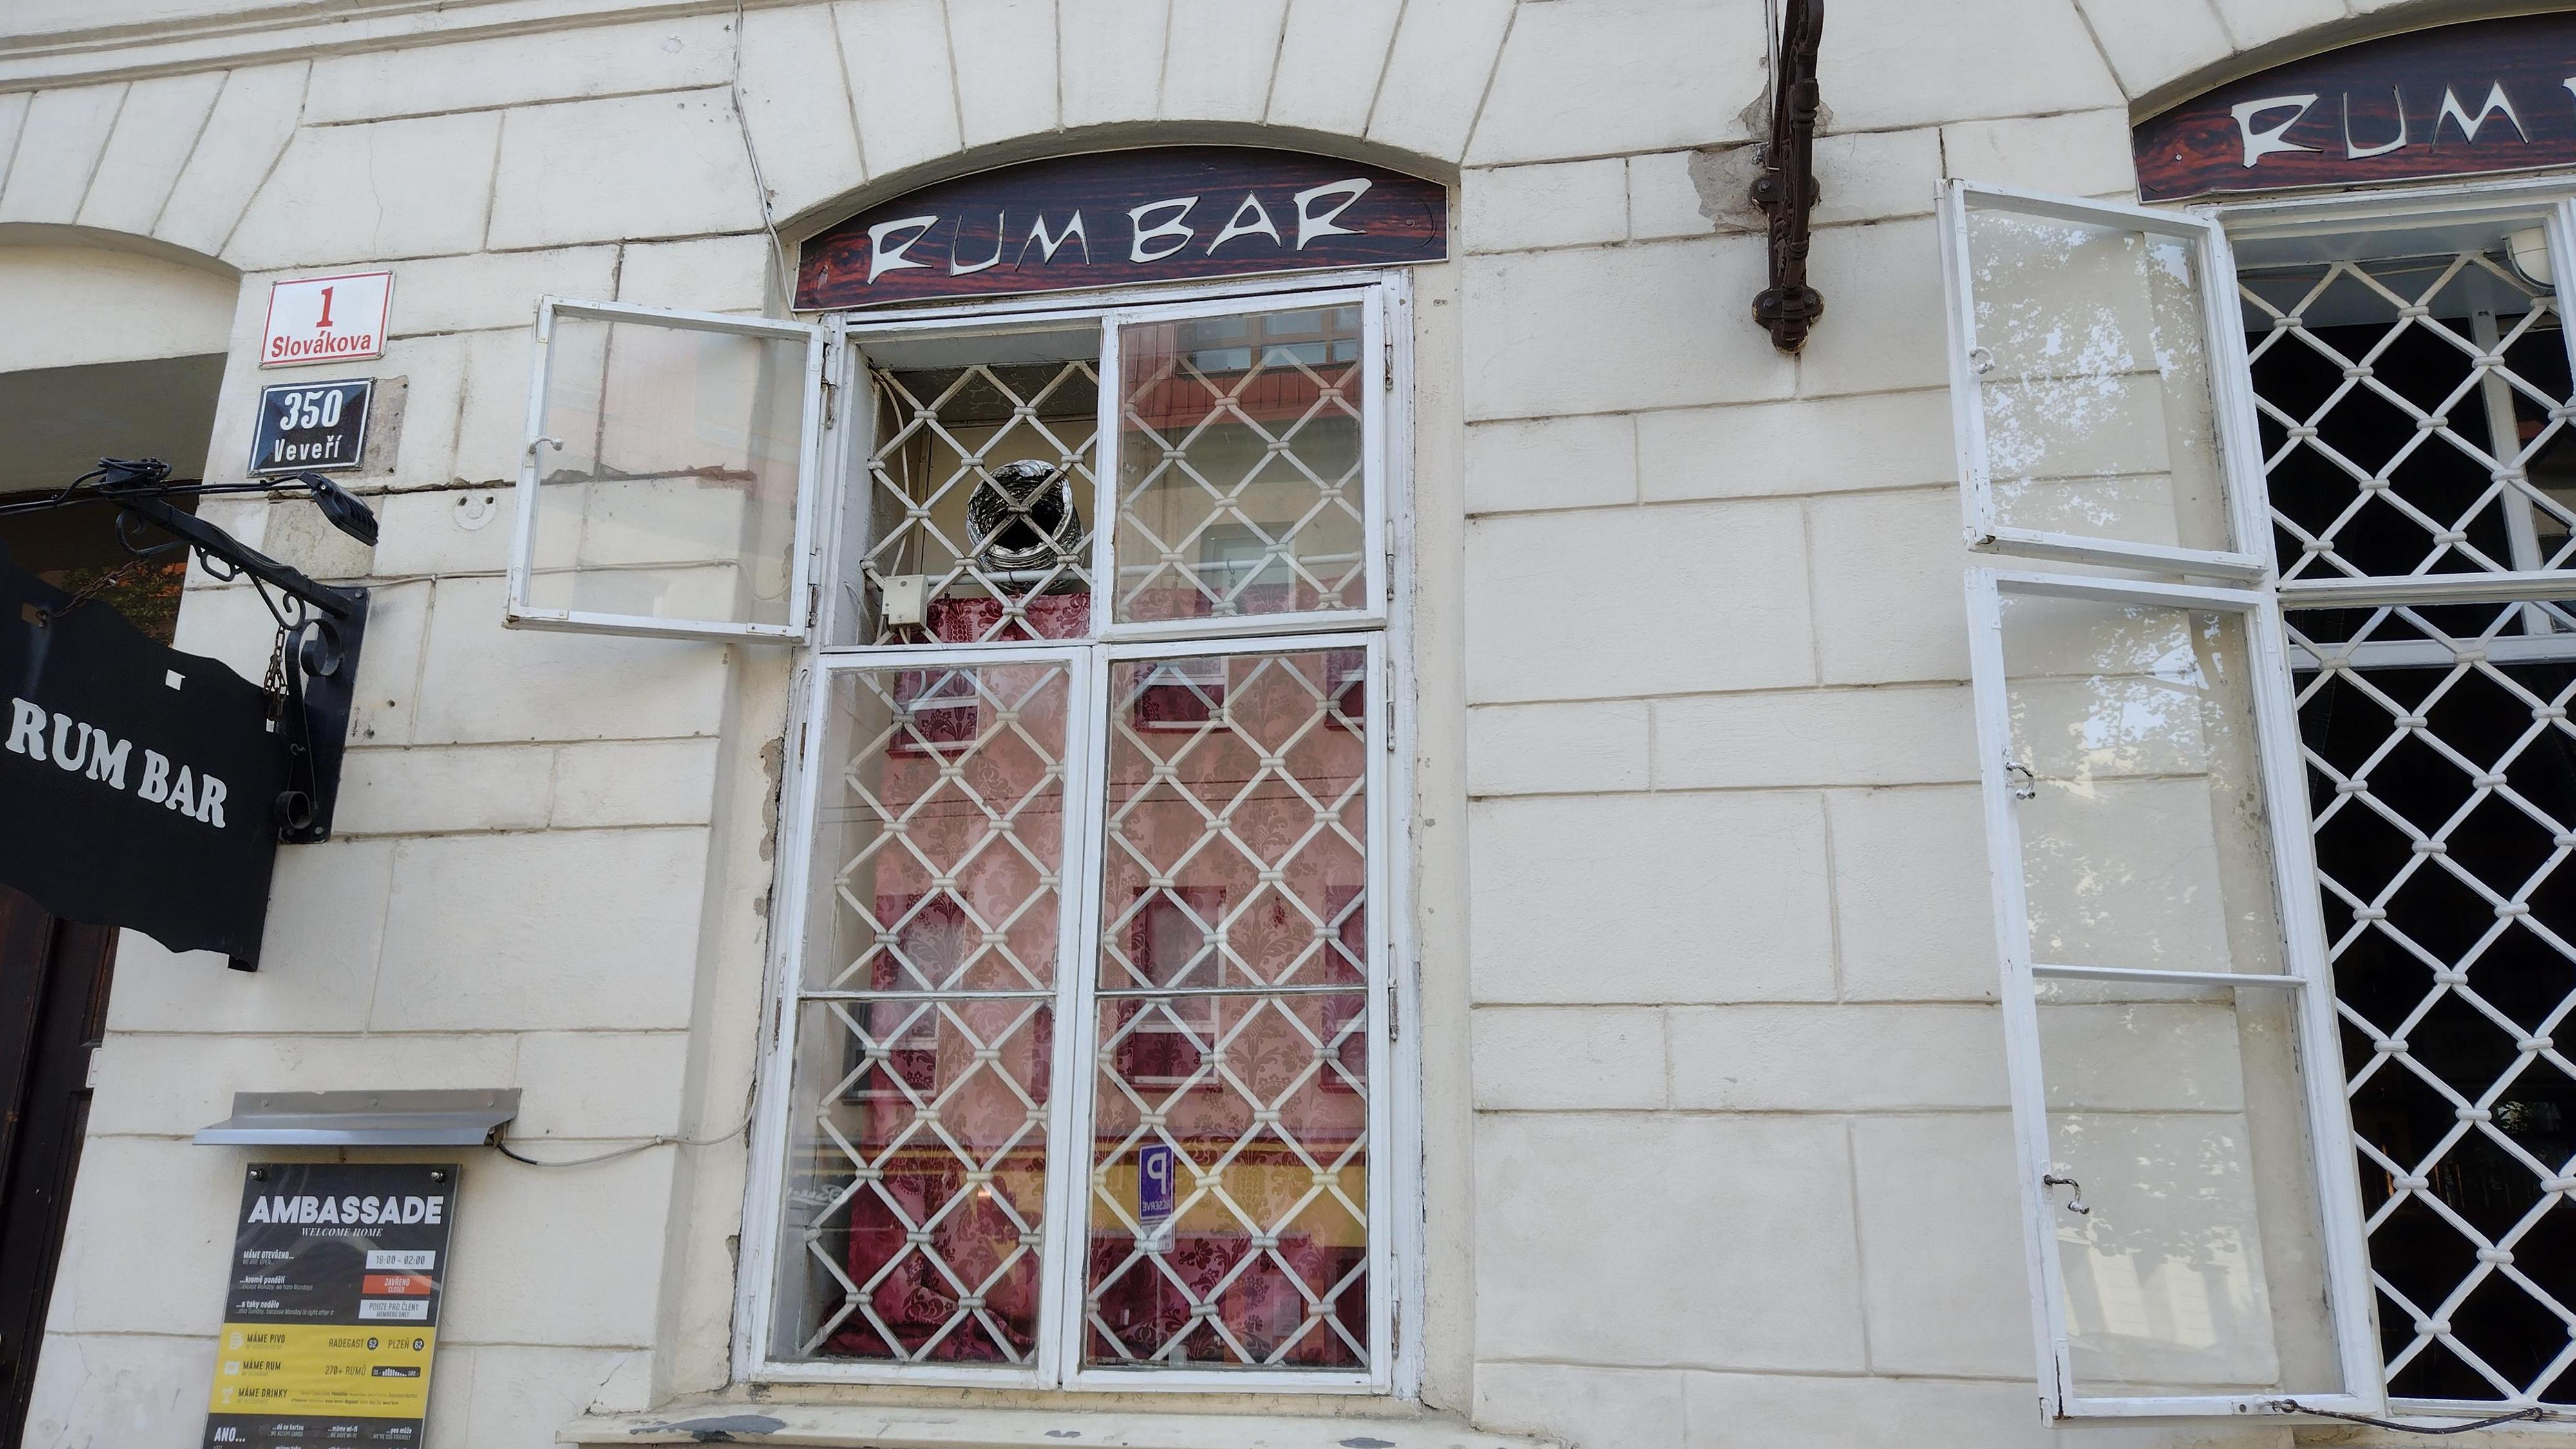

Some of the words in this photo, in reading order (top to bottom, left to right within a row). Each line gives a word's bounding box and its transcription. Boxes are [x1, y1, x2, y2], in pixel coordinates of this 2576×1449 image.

[2230, 79, 2530, 169] RUM
[867, 207, 1091, 285] RUM
[1128, 178, 1374, 263] BAR
[316, 286, 334, 327] 1
[271, 330, 372, 358] Slovákova
[279, 390, 343, 431] 350
[274, 435, 343, 462] Veveří
[5, 697, 132, 790] RUM
[137, 749, 227, 828] BAR
[248, 1196, 444, 1224] AMBASSADE
[302, 1227, 351, 1236] WELCOME
[353, 1228, 384, 1236] HOME
[243, 1249, 261, 1258] MÁME
[376, 1255, 396, 1265] 18:00
[404, 1255, 426, 1265] 02:00
[264, 1276, 286, 1284] pondělí
[384, 1276, 410, 1286] ZAVŘENO
[247, 1300, 259, 1309] taky
[401, 1302, 419, 1311] ČLENY
[247, 1331, 268, 1343] MÁME
[270, 1334, 286, 1343] PIVO
[328, 1338, 365, 1348] RADEGAST
[388, 1338, 410, 1349] PLZEŇ
[414, 1340, 422, 1349] 62
[243, 1359, 263, 1370] MÁME
[265, 1361, 281, 1370] RUM
[345, 1365, 367, 1376] RUMŮ
[238, 1386, 260, 1397] MÁME
[261, 1388, 289, 1398] DRINKY
[214, 1426, 246, 1442] ANO...
